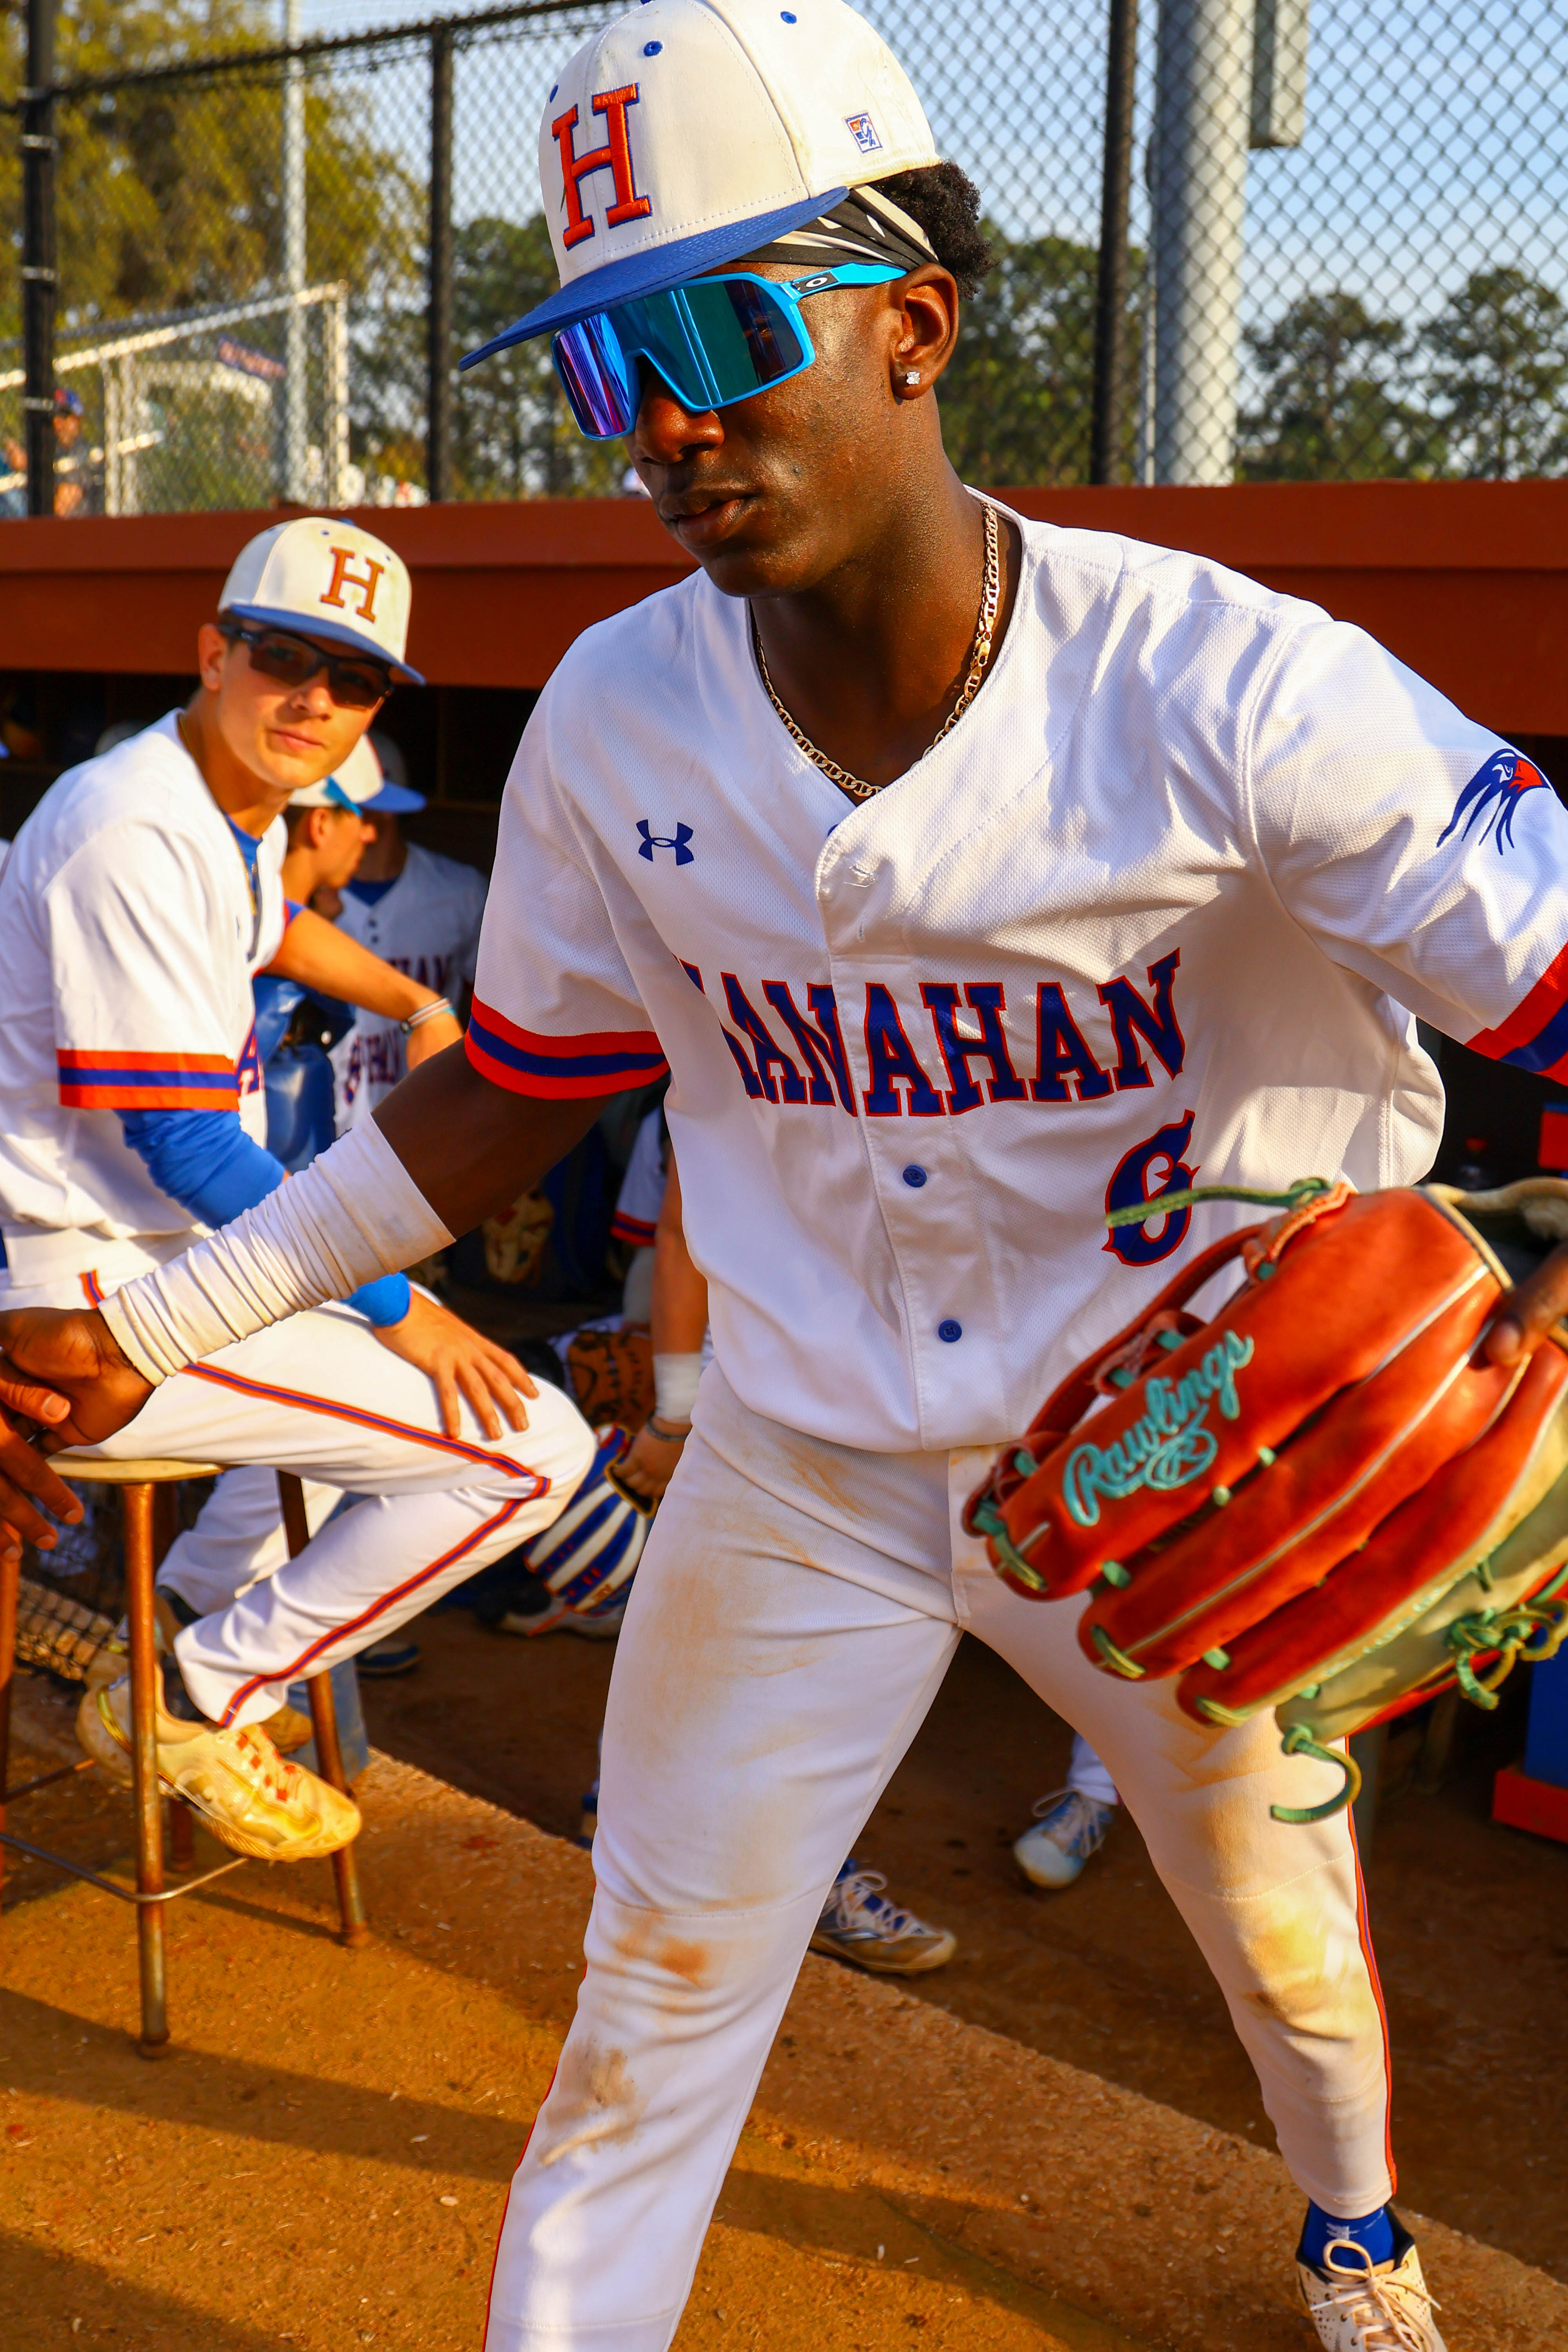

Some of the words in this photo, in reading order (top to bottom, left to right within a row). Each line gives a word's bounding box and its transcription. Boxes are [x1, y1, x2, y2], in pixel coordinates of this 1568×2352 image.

[552, 82, 652, 250] H
[319, 545, 385, 623] H
[1063, 1330, 1254, 1526] Rawlings
